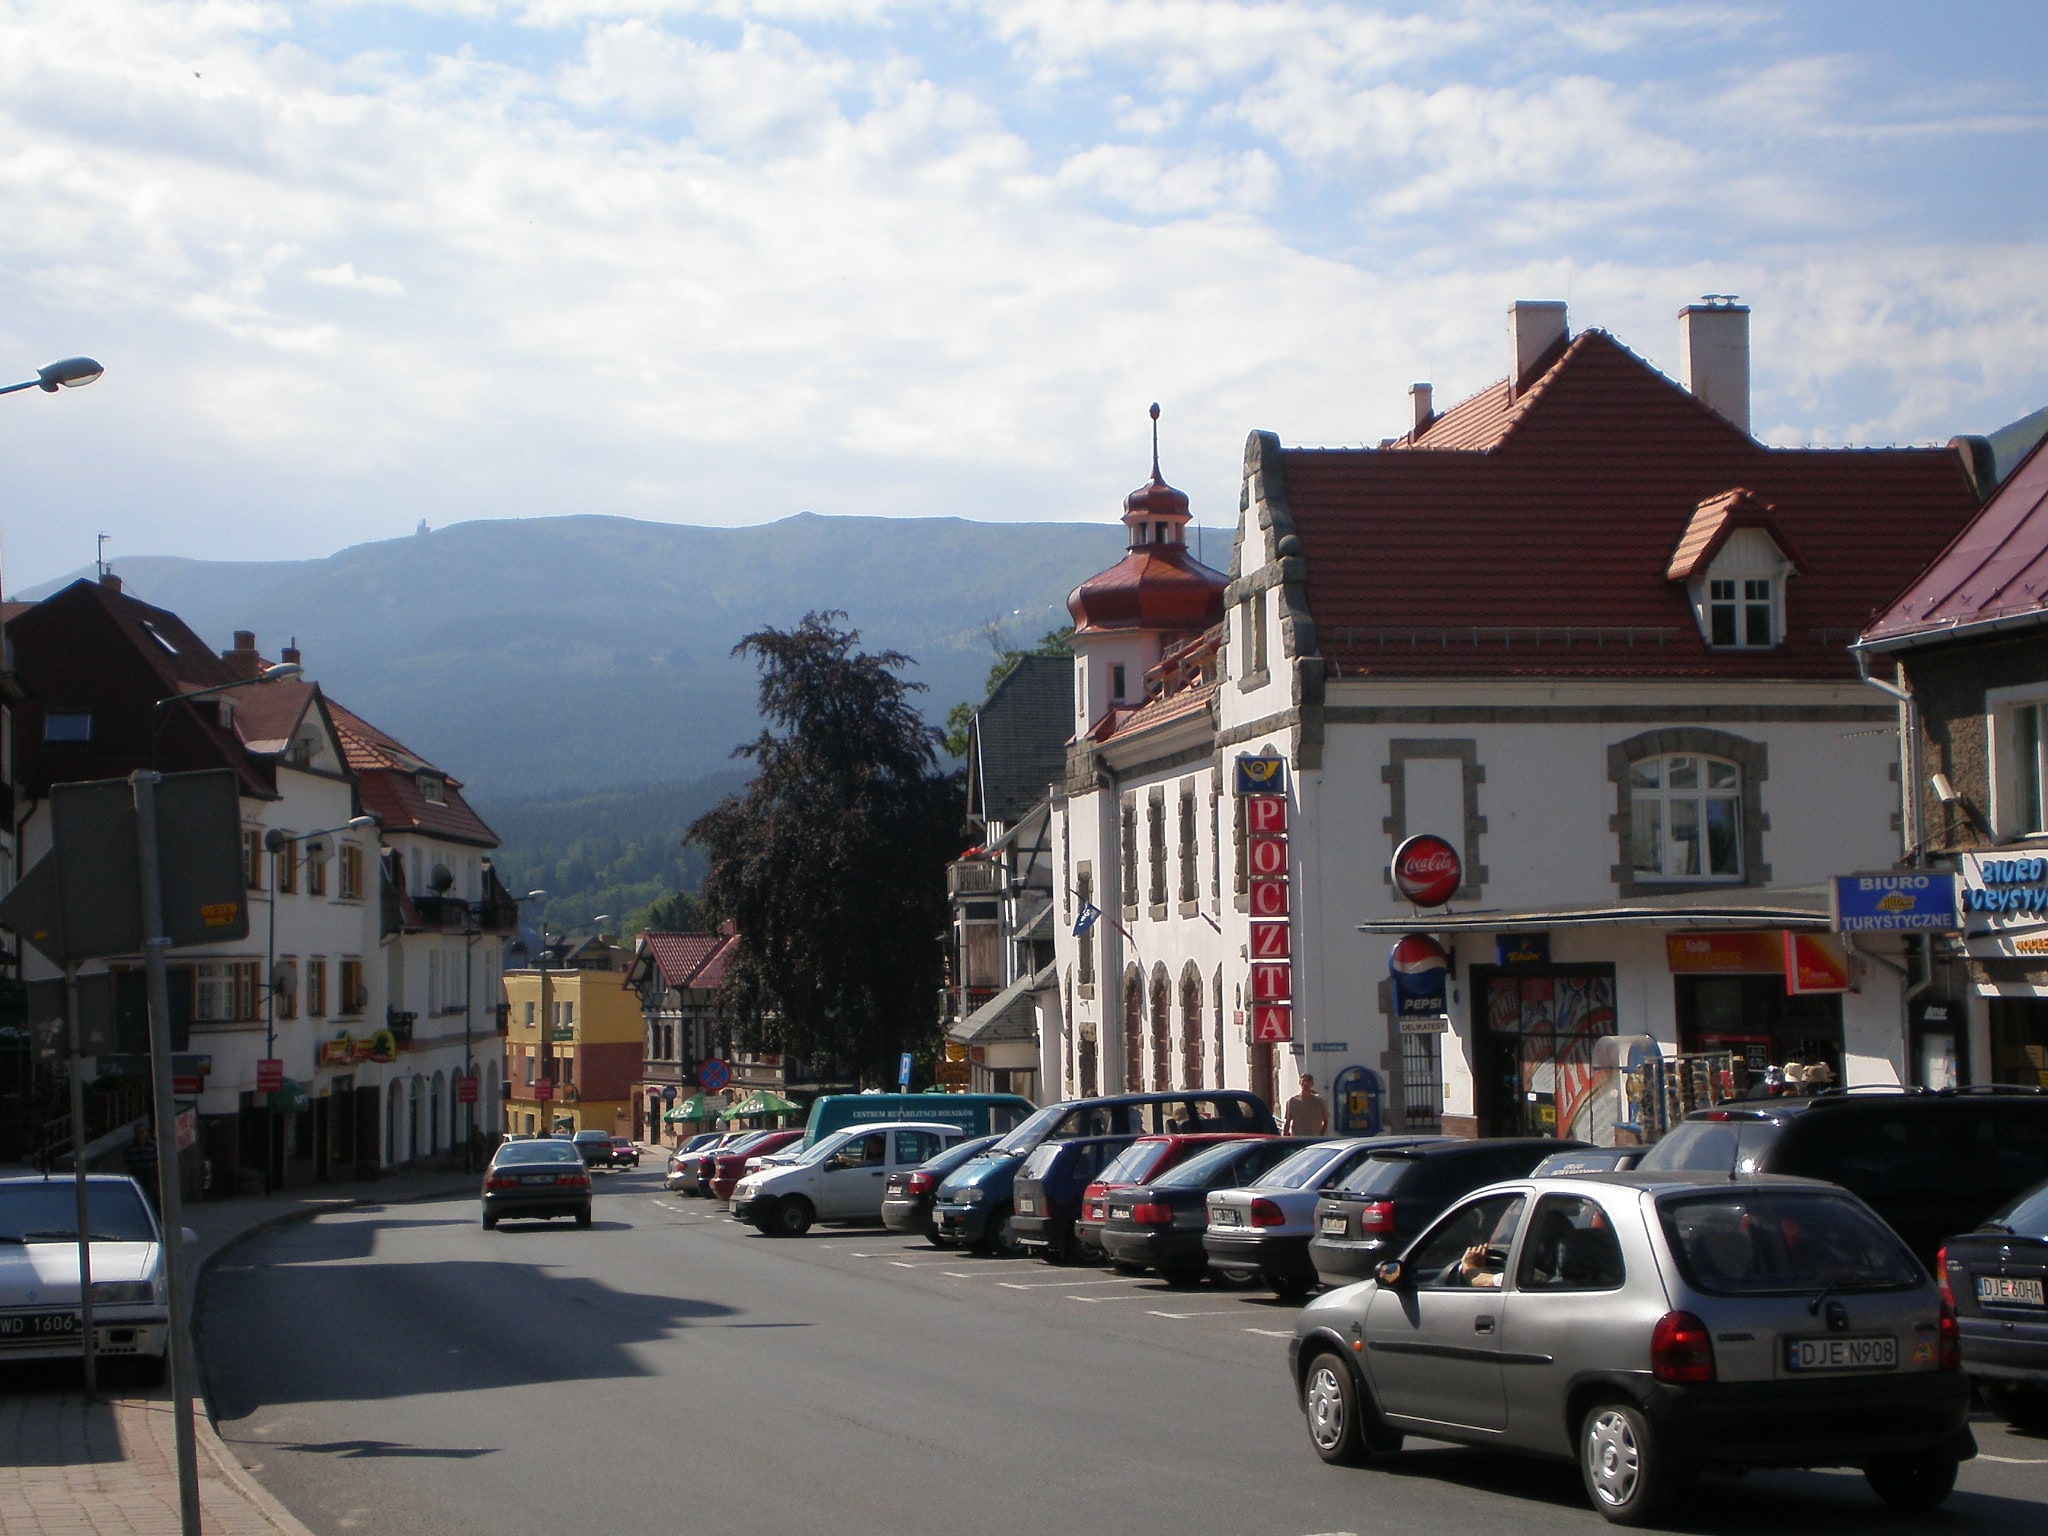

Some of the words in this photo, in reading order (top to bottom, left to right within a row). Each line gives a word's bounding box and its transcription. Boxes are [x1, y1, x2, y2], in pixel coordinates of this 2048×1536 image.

[1860, 876, 1930, 891] BIURO
[1254, 800, 1287, 1040] POCZTA
[1842, 913, 1952, 930] TURYSTYCZNE
[1404, 998, 1442, 1010] PEPSI
[1402, 1022, 1446, 1031] DELIKATESY
[1983, 1278, 2009, 1297] DJE
[34, 1315, 73, 1331] 1606
[1802, 1343, 1844, 1365] DJE
[1849, 1341, 1894, 1363] N908
